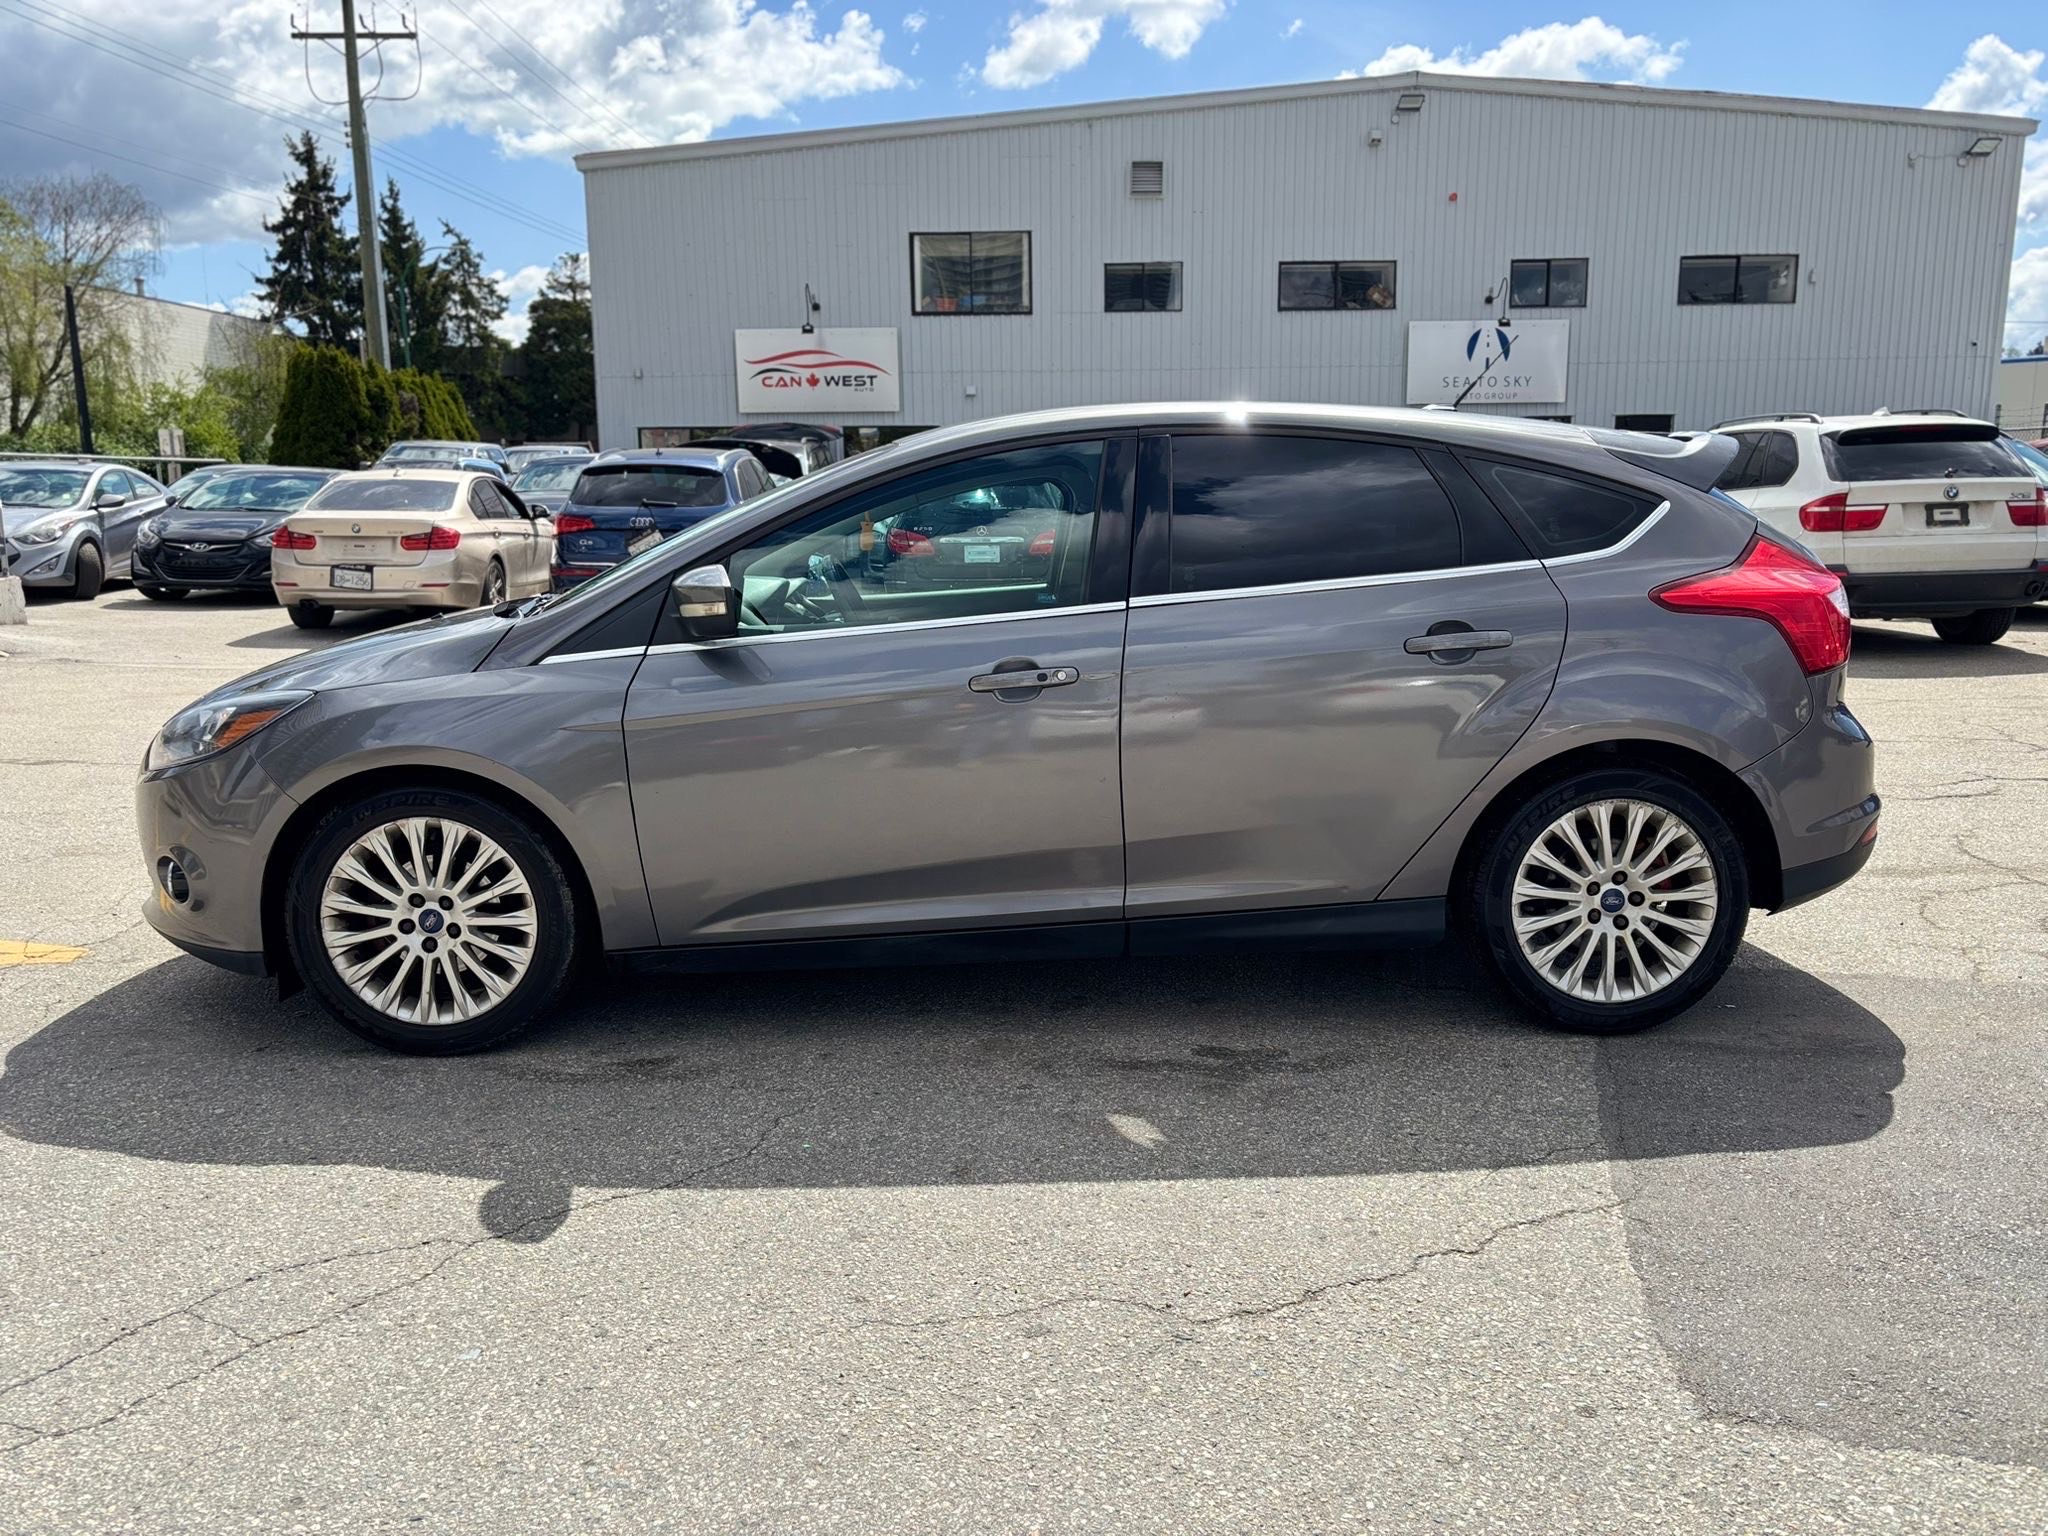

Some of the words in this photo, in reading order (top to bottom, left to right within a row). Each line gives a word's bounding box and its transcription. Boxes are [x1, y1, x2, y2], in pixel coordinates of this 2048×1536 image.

[761, 376, 802, 388] CAN
[824, 375, 878, 387] WEST
[1442, 376, 1470, 388] SEA
[1477, 376, 1498, 388] TO
[1503, 376, 1533, 388] SKY
[1484, 392, 1518, 400] GROUP
